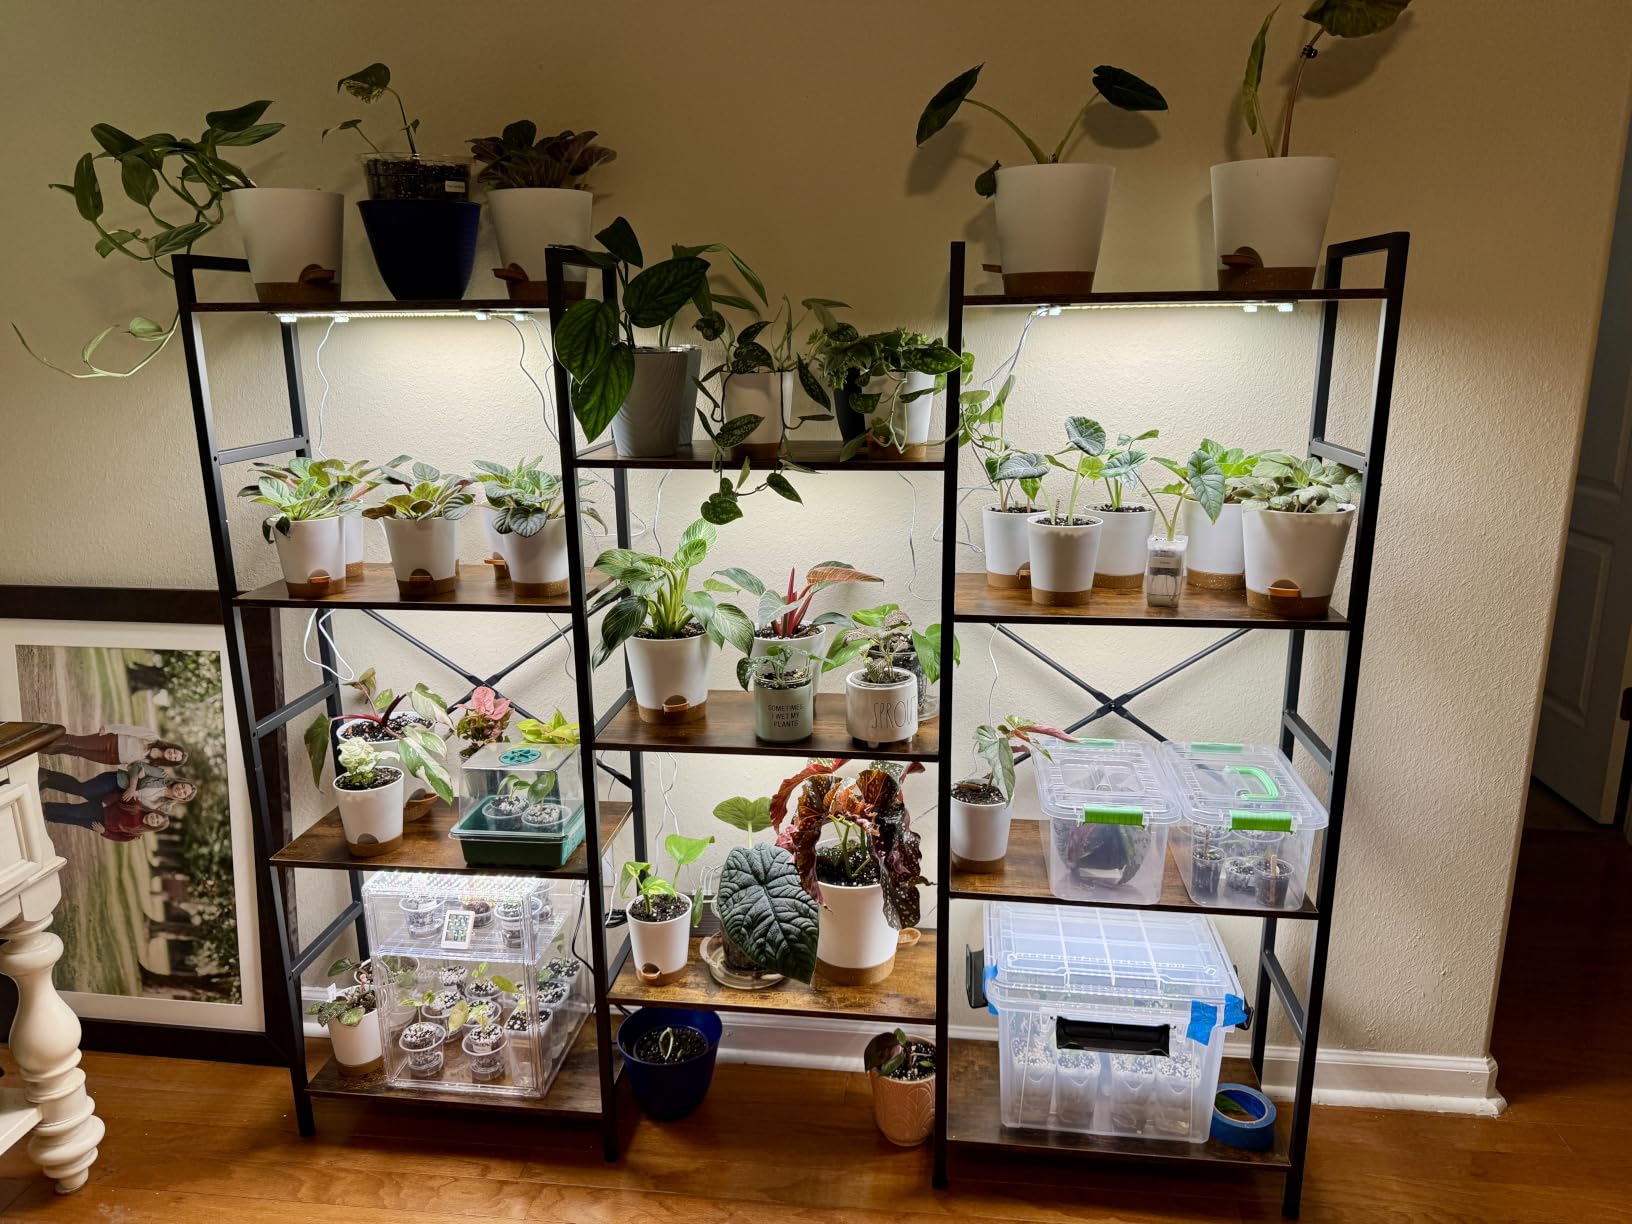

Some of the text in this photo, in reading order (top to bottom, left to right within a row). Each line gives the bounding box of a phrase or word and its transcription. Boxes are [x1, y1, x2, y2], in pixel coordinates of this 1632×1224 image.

[767, 703, 805, 711] SOMETIMES
[776, 712, 789, 720] WET
[790, 711, 800, 719] MY
[773, 719, 800, 728] PLANTS
